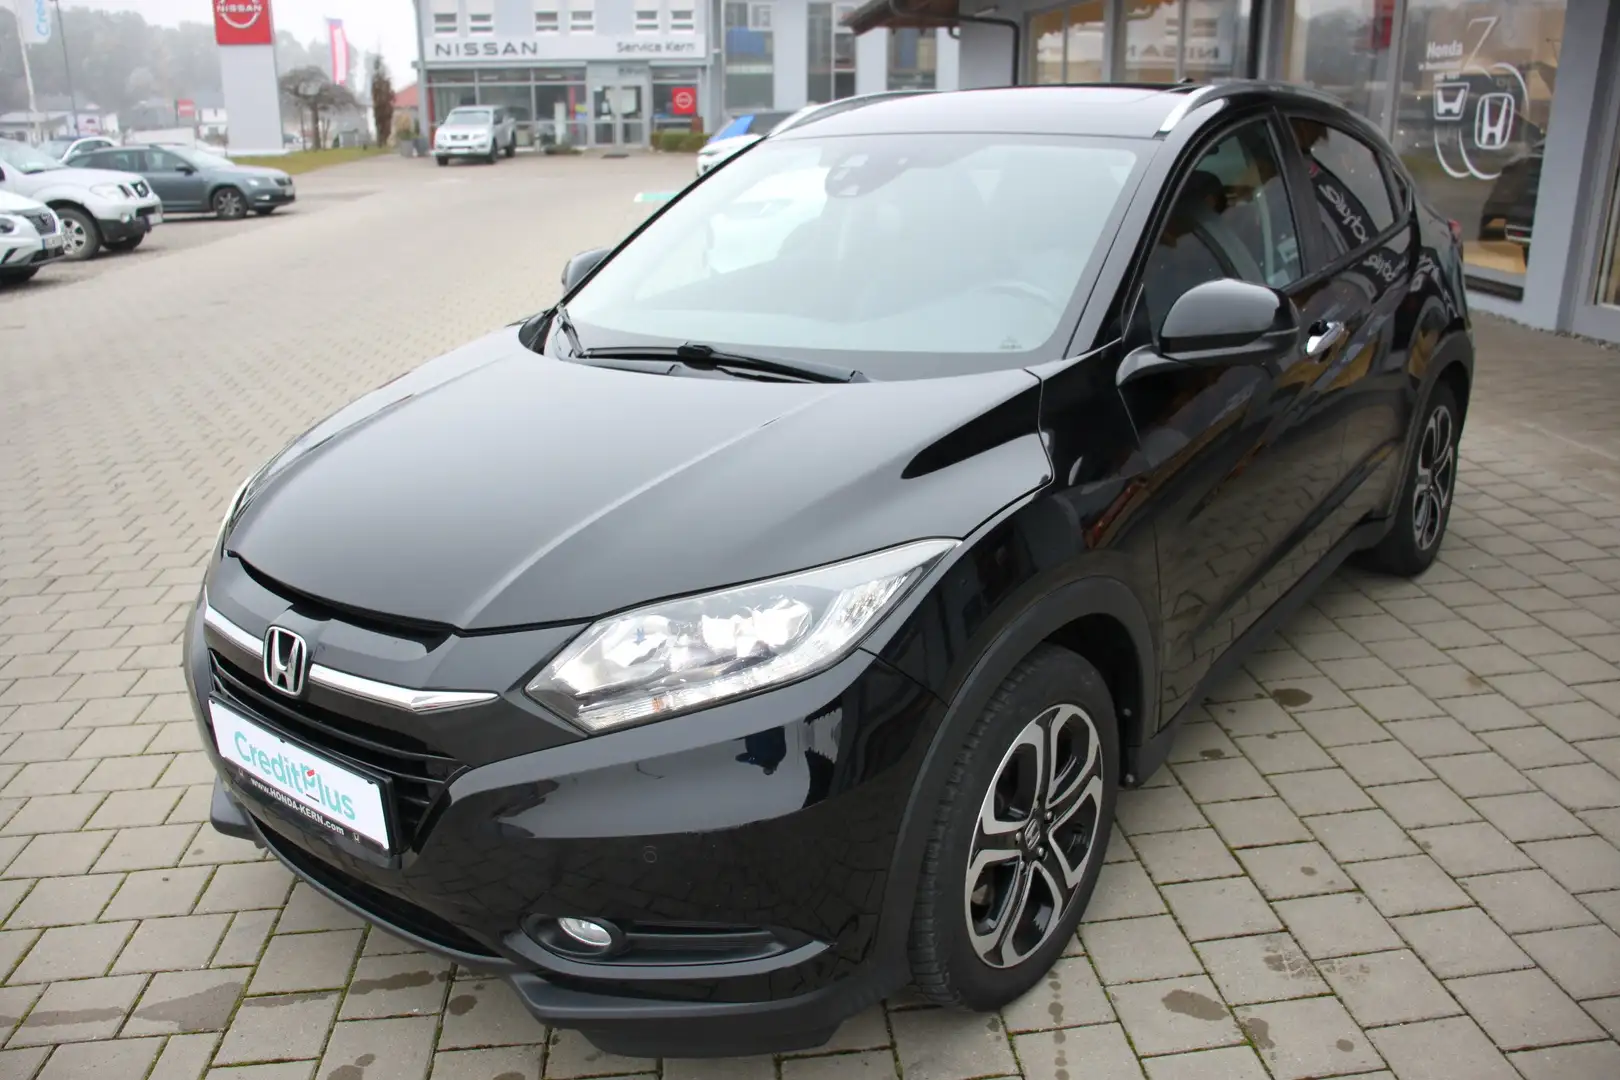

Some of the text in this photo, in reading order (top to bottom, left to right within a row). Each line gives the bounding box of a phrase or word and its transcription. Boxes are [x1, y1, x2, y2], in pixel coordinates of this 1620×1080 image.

[216, 4, 262, 13] NISSAN
[435, 42, 537, 56] NISSAN
[616, 42, 696, 54] Service Kern
[1426, 40, 1463, 60] Honda
[250, 778, 345, 836] www.HONDA-KERN.com
